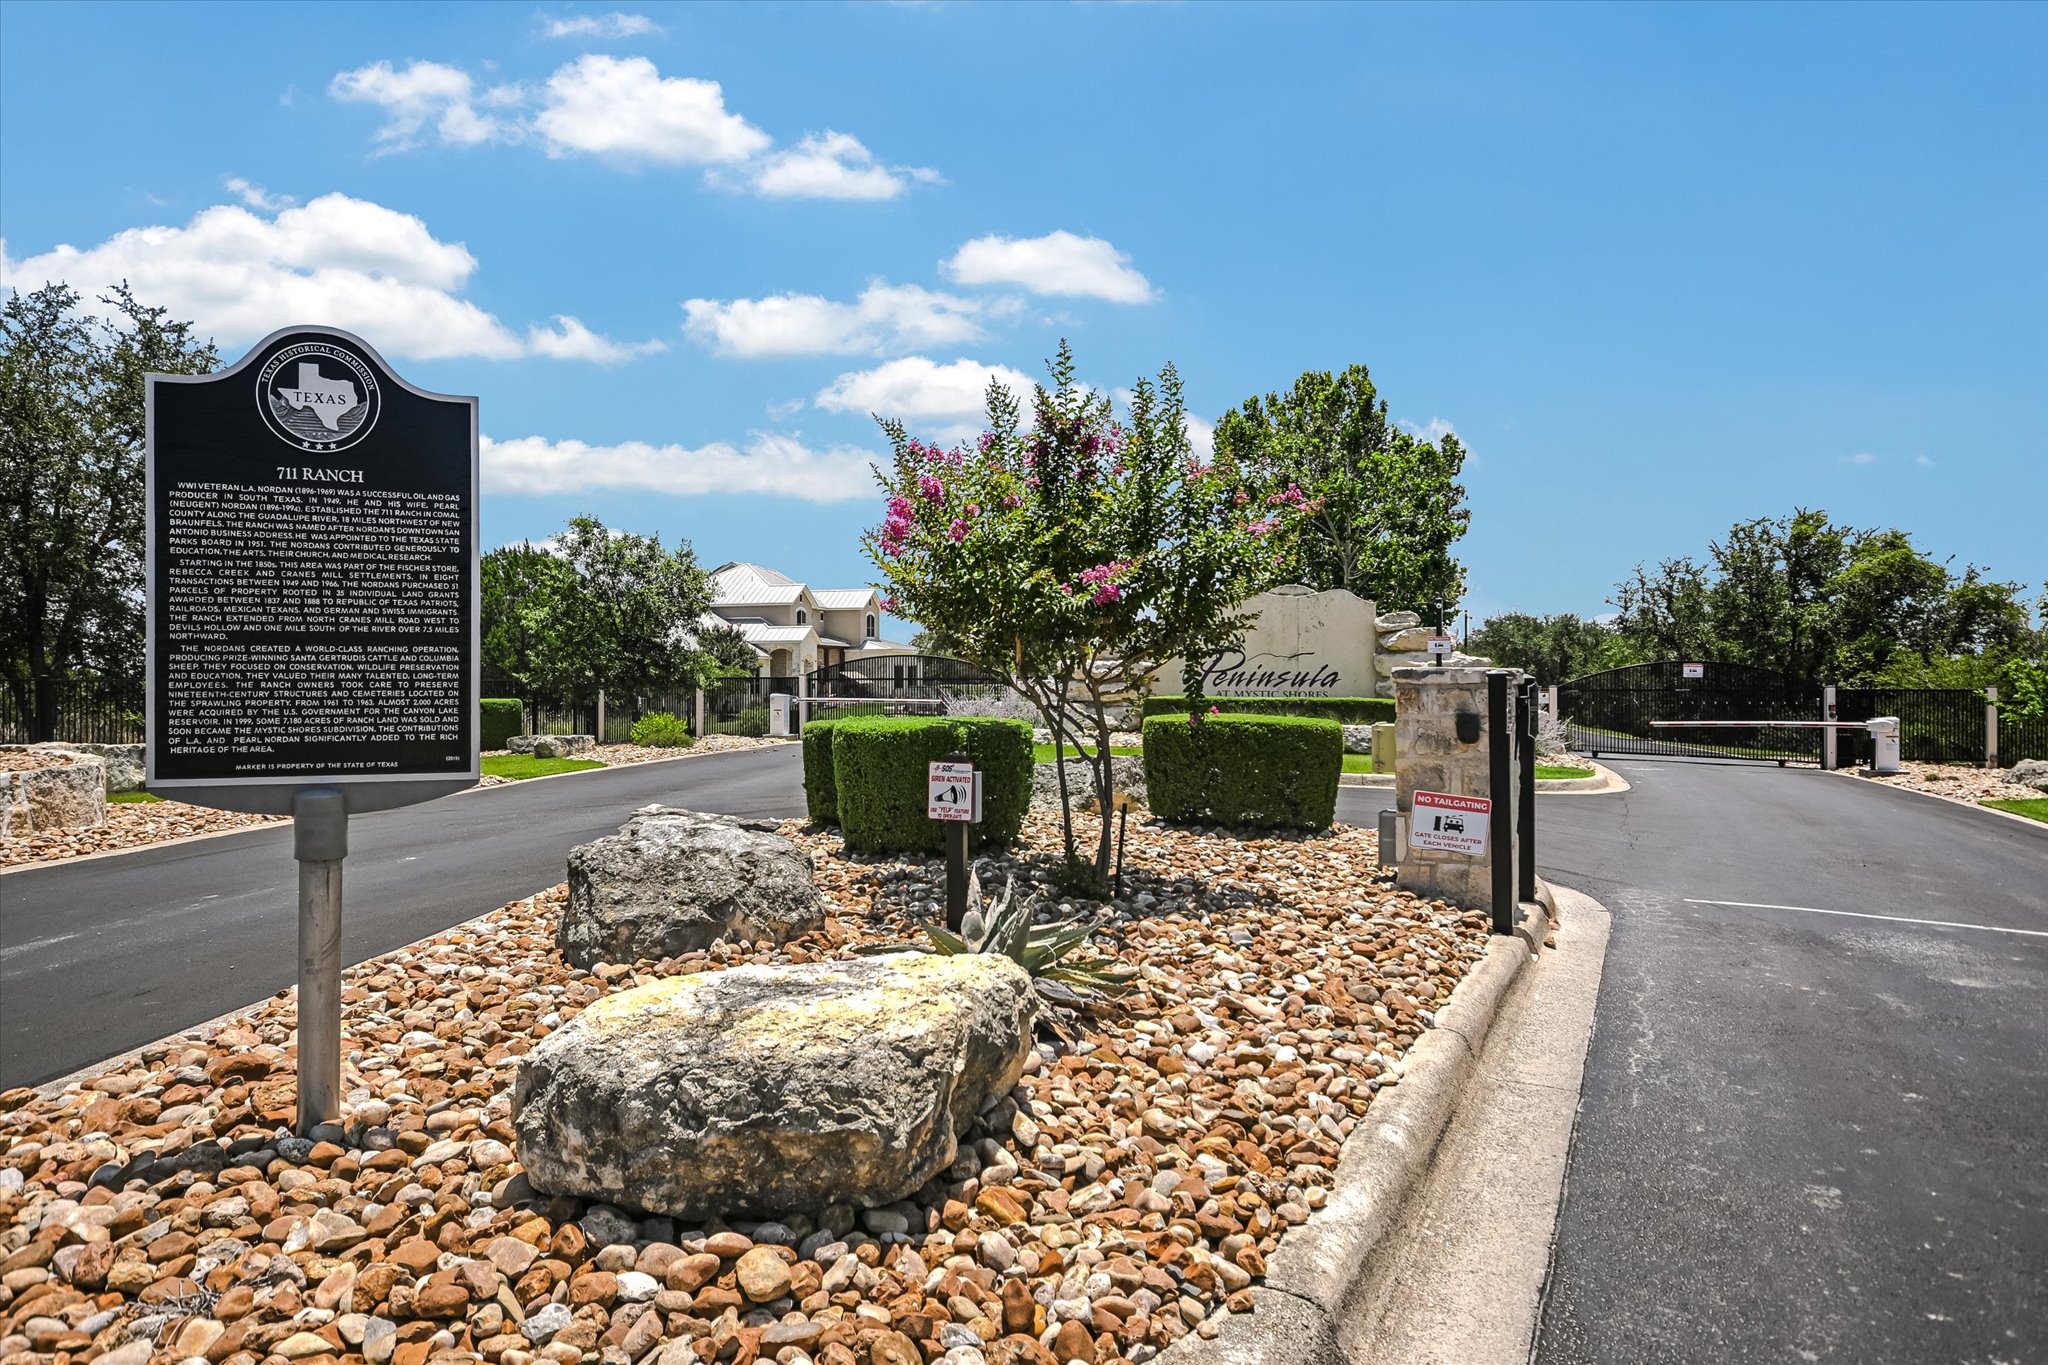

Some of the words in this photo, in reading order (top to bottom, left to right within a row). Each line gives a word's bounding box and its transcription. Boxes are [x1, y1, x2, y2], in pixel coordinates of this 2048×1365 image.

[261, 359, 280, 383] TEXAS
[279, 345, 331, 362] HISTORICAL
[333, 349, 375, 391] COMMISSION
[293, 391, 346, 405] TEXAS
[276, 466, 298, 480] 711
[302, 467, 364, 483] RANCH
[362, 490, 412, 499] SUCCESSFUL
[1200, 647, 1342, 688] Peninsula
[1434, 797, 1488, 810] TAILGATING
[1434, 833, 1459, 842] CLOSES
[1444, 842, 1471, 850] VEHICLE
